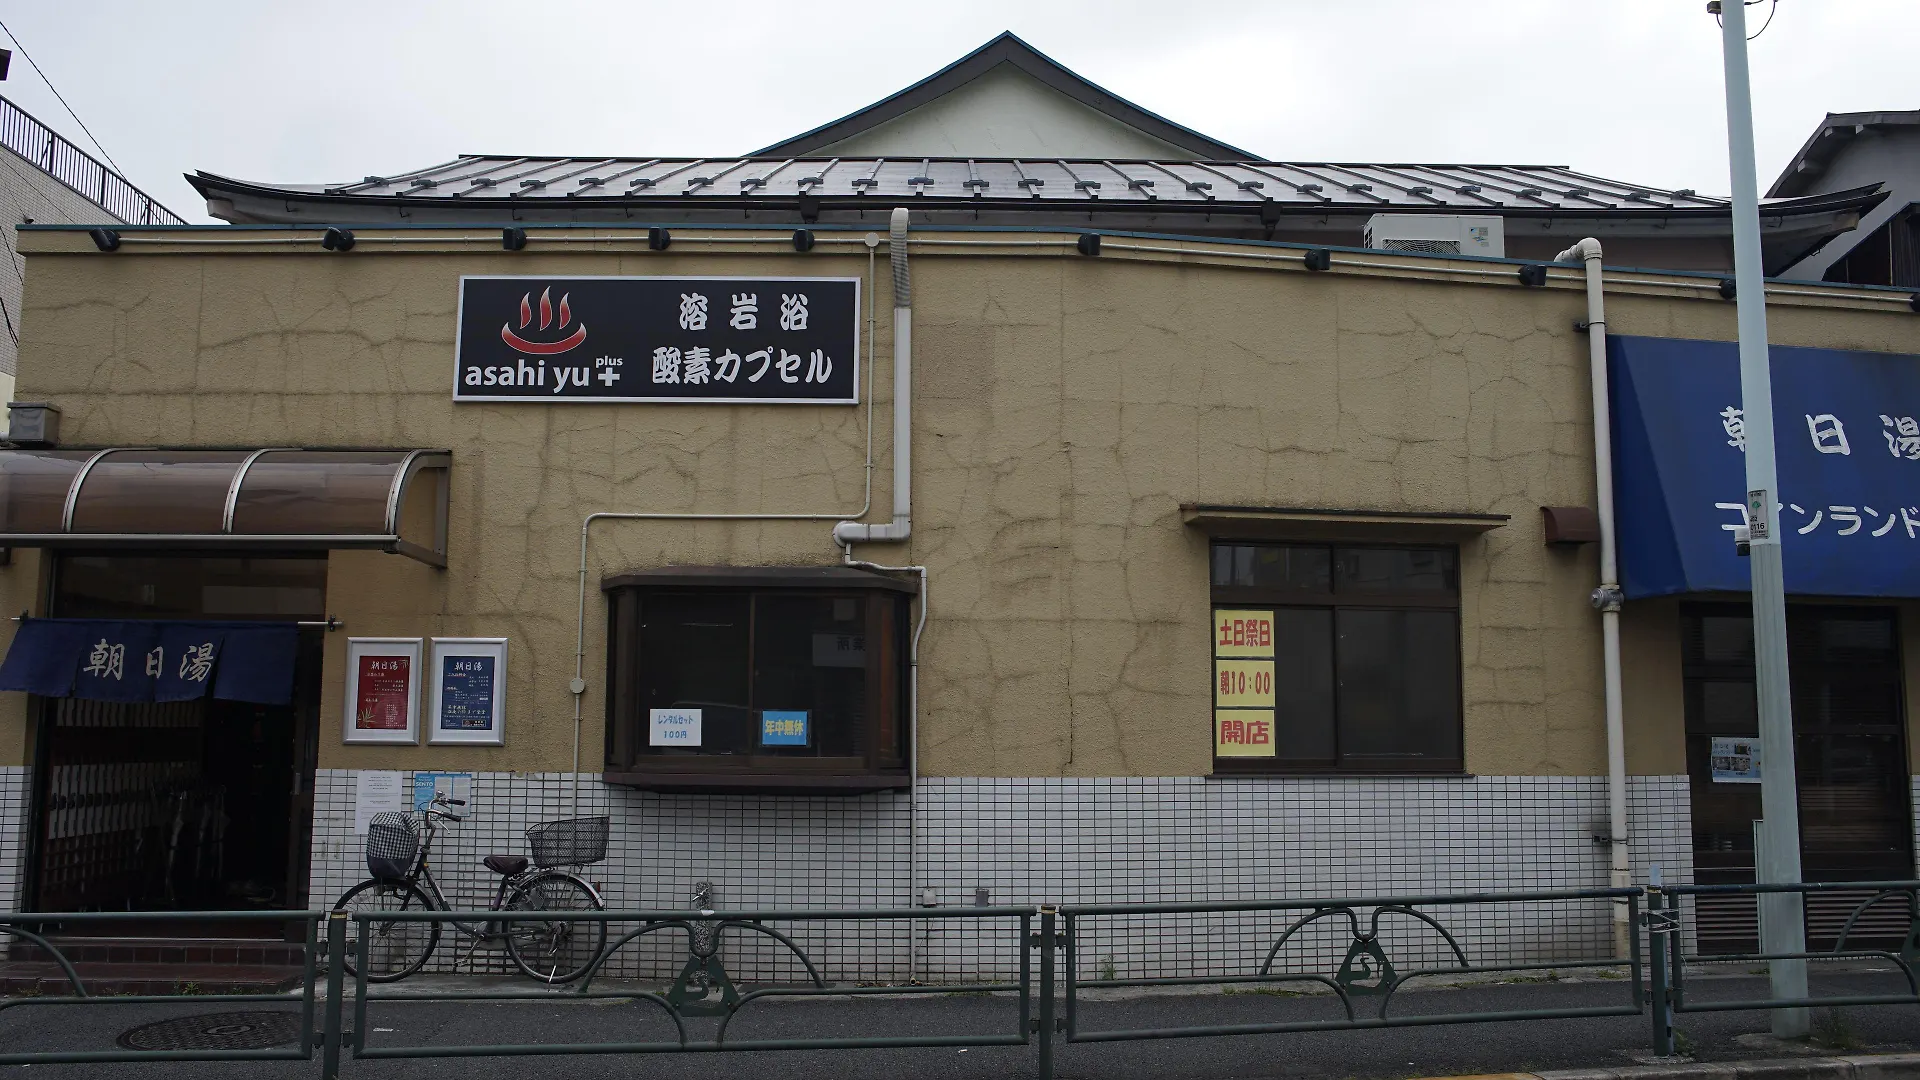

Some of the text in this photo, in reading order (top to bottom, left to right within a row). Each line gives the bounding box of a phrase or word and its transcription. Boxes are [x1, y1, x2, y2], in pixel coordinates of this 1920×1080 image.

[679, 293, 809, 331] 溶岩浴
[465, 359, 545, 386] asahi
[552, 367, 590, 393] yu
[596, 356, 623, 368] plus
[652, 346, 833, 385] 酸素カプセル
[1714, 502, 1920, 539] コンランド
[1219, 619, 1271, 647] 土日祭日
[83, 638, 214, 682] 朝日湯
[663, 730, 688, 739] 100円
[765, 719, 804, 736] 年中無休
[1220, 720, 1270, 745] 開店
